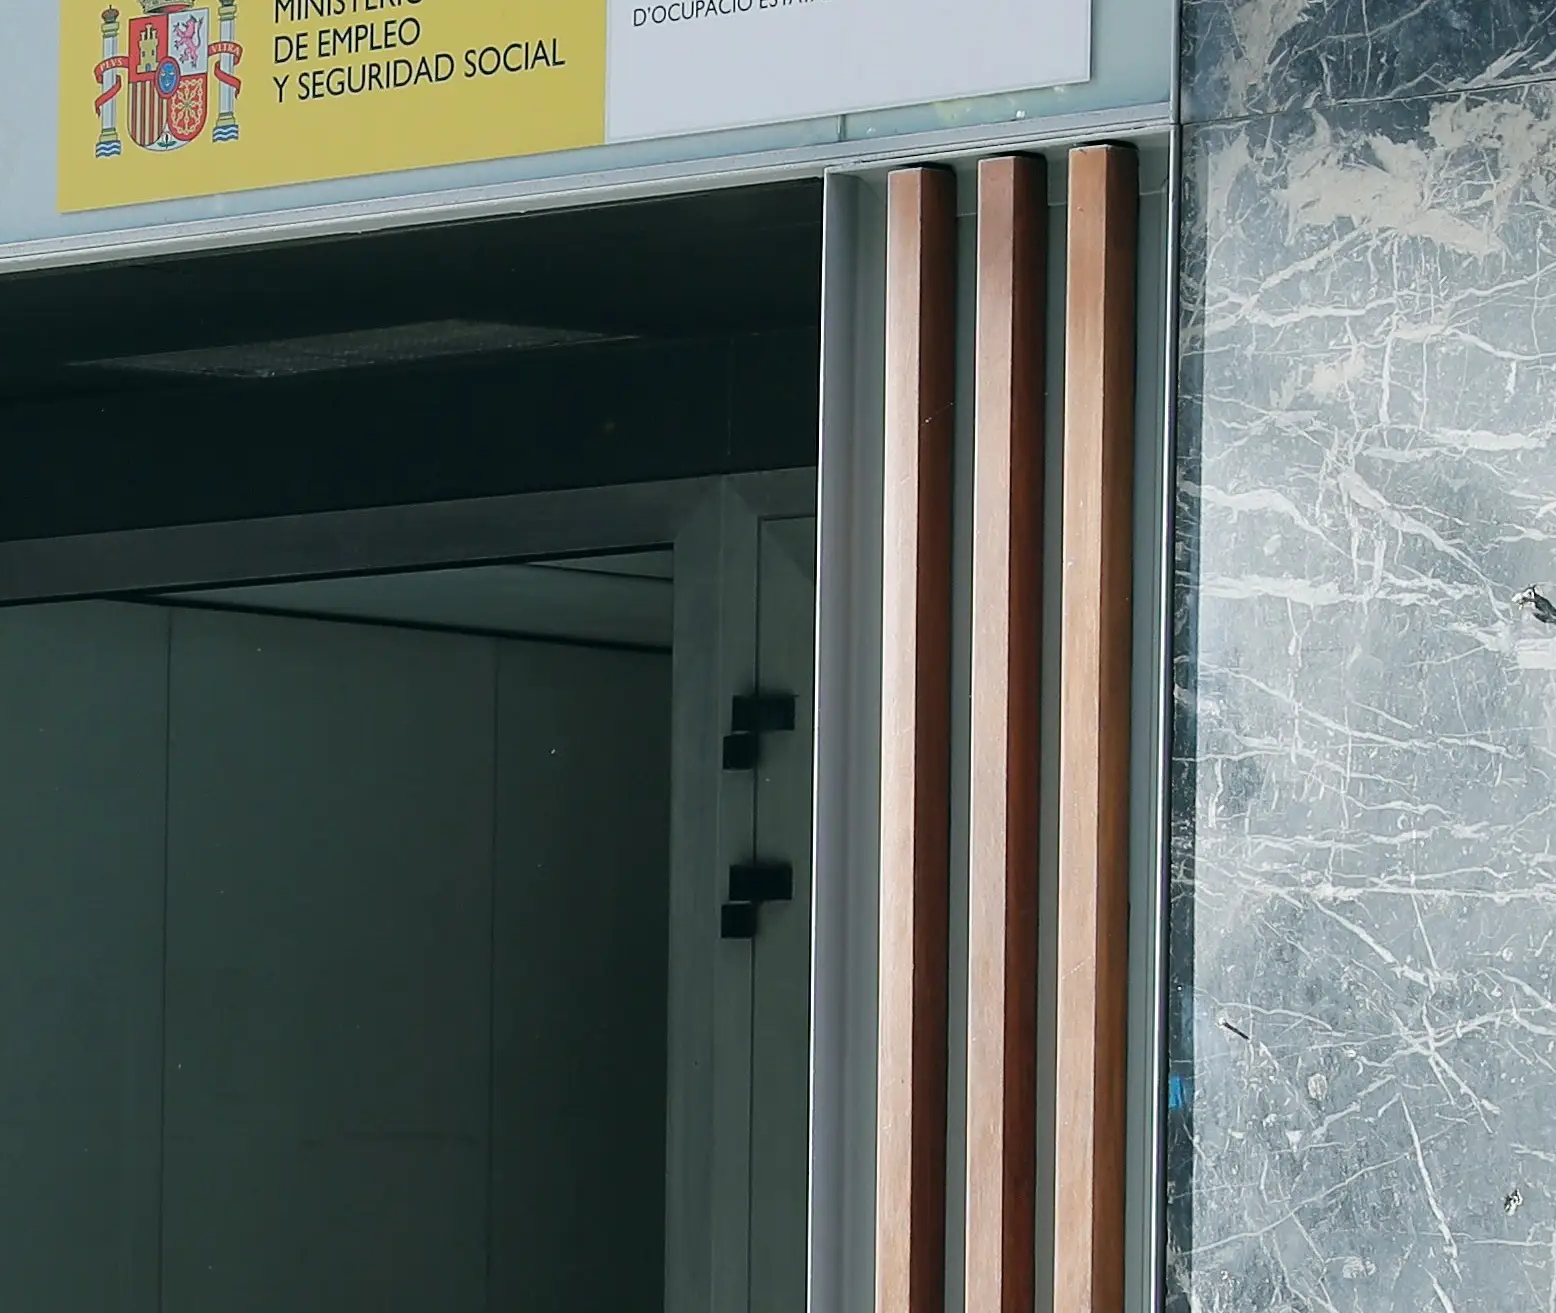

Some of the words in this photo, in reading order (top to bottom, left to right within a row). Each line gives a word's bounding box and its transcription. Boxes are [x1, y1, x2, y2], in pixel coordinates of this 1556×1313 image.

[274, 33, 309, 64] DE
[318, 17, 421, 58] EMPLEO
[273, 75, 290, 103] Y
[297, 53, 455, 101] SEGURIDAD
[464, 38, 566, 78] SOCIAL
